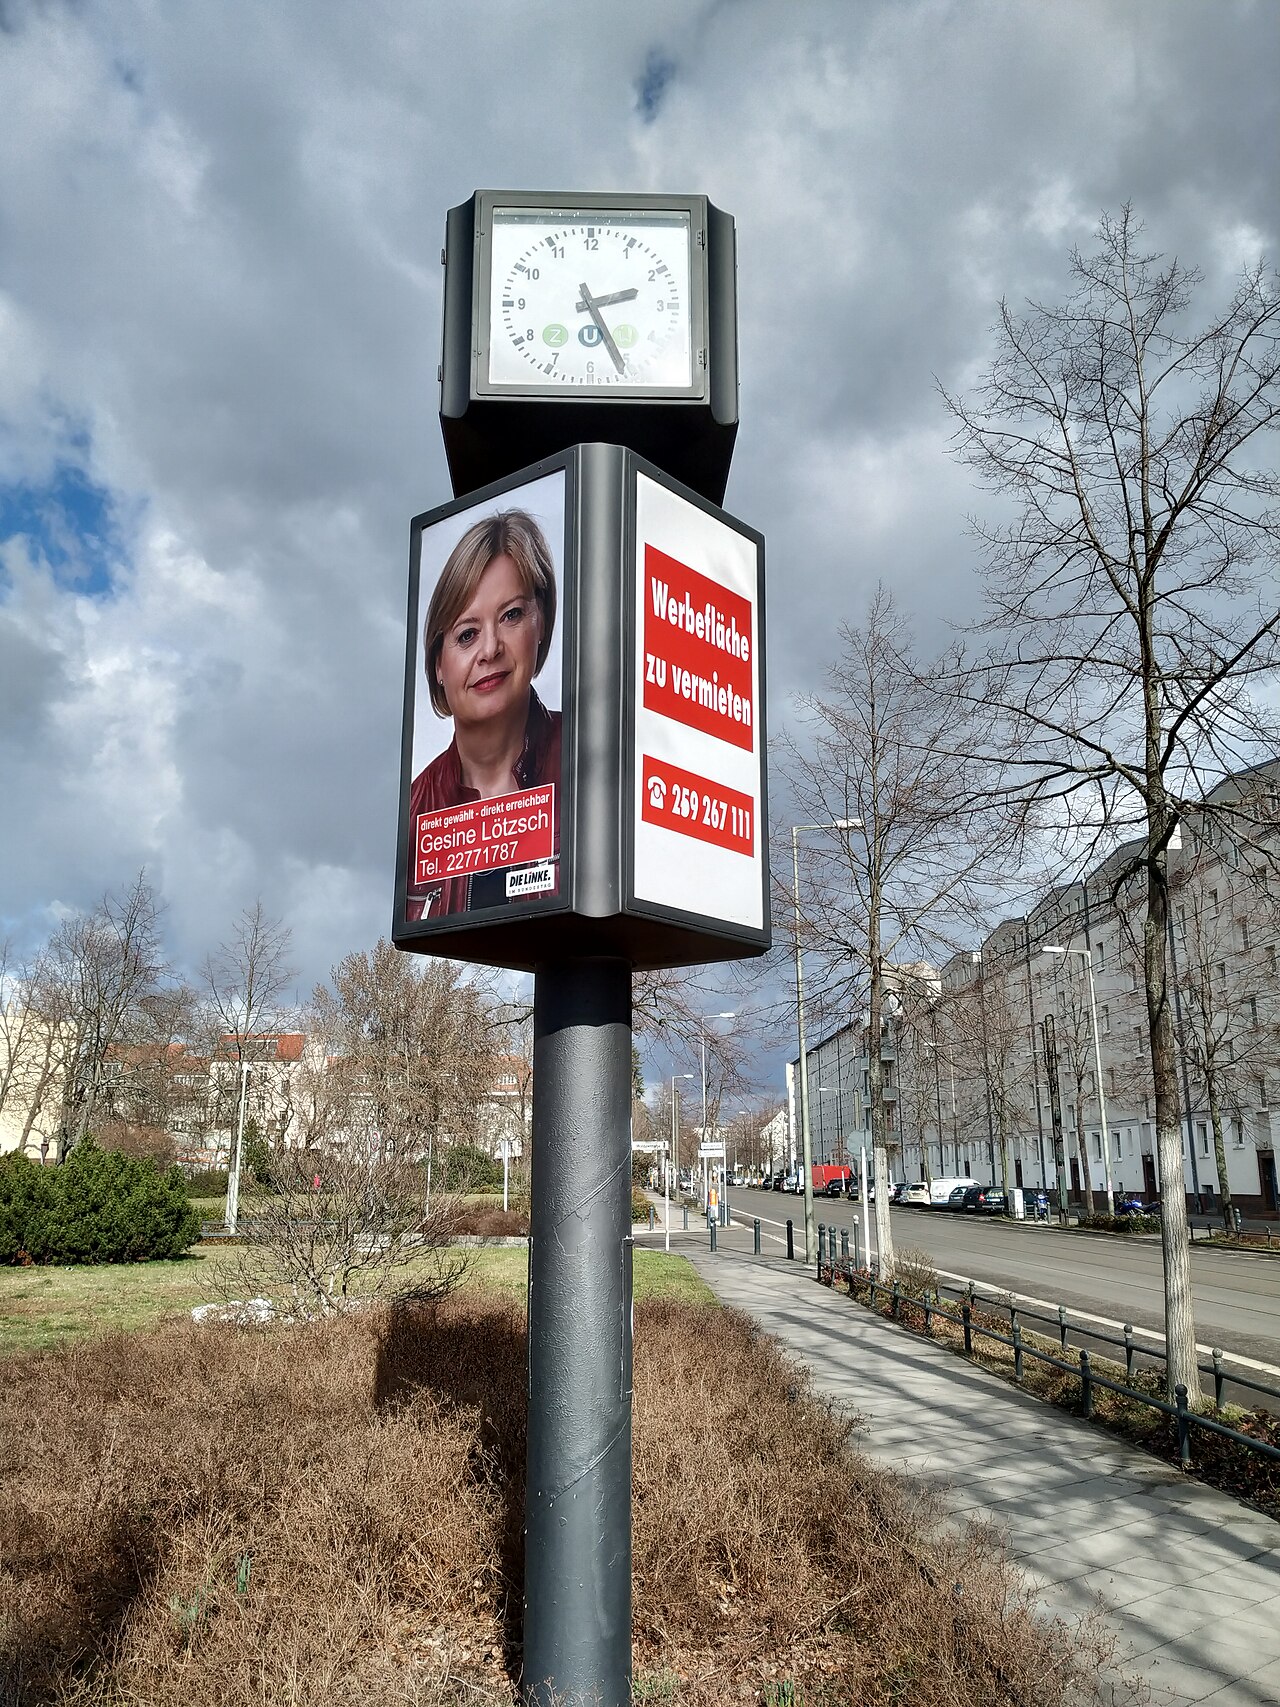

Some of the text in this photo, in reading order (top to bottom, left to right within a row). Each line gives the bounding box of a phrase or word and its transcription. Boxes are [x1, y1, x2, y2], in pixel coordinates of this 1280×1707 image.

[584, 239, 599, 250] 12
[551, 246, 565, 259] 11
[622, 247, 629, 259] 1
[525, 268, 540, 280] 10
[647, 269, 656, 282] 2
[517, 298, 526, 310] 9
[656, 300, 665, 312] 3
[526, 329, 534, 341] 8
[549, 328, 562, 343] Z
[583, 328, 599, 343] U
[551, 352, 560, 365] 7
[586, 361, 595, 373] 6
[651, 576, 750, 662] Werbefläche
[671, 664, 751, 727] vermieten
[420, 816, 442, 831] direkt
[443, 810, 474, 829] gewählt
[480, 803, 504, 818] direkt
[505, 793, 550, 811] erreichbar
[671, 783, 750, 840] 259 267 111
[420, 809, 548, 854] Gesine Lötzsch
[419, 840, 519, 877] Tel. 22771787
[509, 874, 523, 887] DIE
